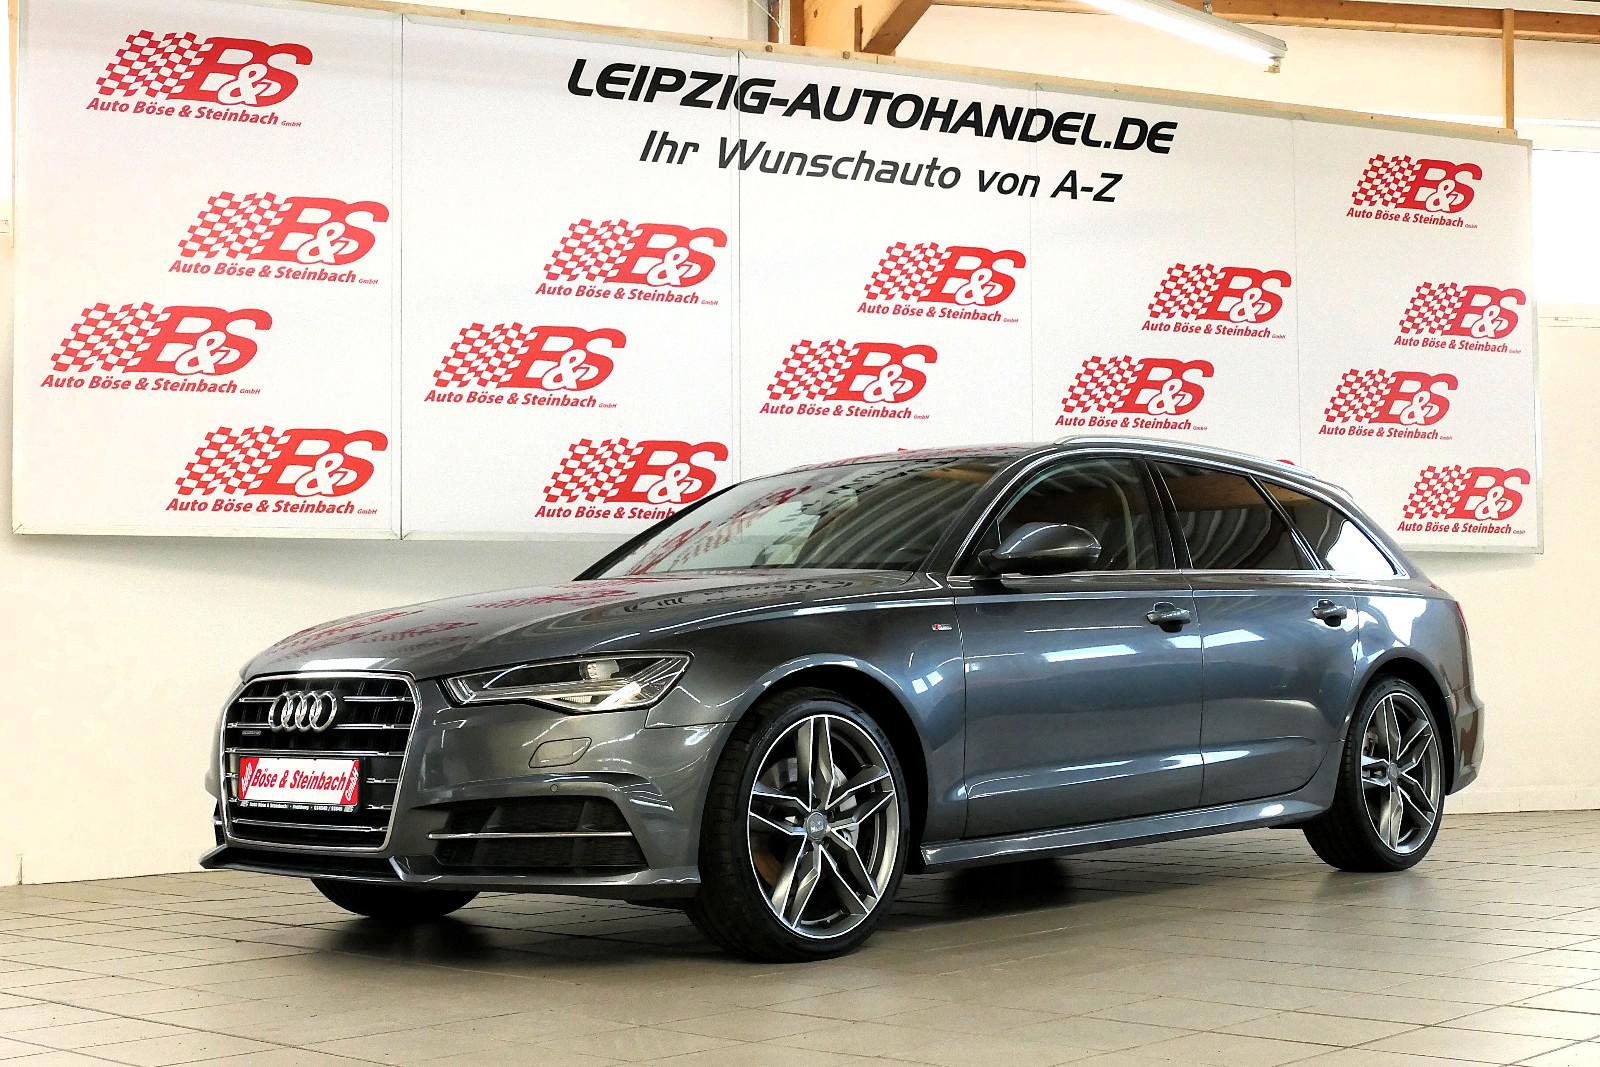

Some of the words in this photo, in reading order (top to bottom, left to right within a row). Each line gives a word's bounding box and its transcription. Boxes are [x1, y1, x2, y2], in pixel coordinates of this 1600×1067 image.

[86, 98, 129, 112] Auto
[132, 101, 175, 116] Böse
[178, 105, 192, 117] &
[194, 107, 278, 125] Steinbach
[567, 58, 1178, 155] LEIPZIG-AUTOHANDEL.DE
[639, 130, 700, 165] Ihr
[718, 136, 961, 189] Wunschauto
[978, 169, 1041, 198] von
[1050, 169, 1124, 203] A-Z
[1346, 207, 1373, 218] Auto
[1375, 209, 1400, 221] Böse
[1402, 212, 1411, 222] &
[1412, 213, 1463, 227] Steinbach
[168, 260, 211, 274] Auto
[214, 263, 255, 276] Böse
[258, 265, 272, 277] &
[274, 266, 356, 283] Steinbach
[536, 283, 572, 296] Auto
[575, 285, 611, 298] Böse
[614, 288, 625, 299] &
[629, 289, 699, 304] Steinbach
[858, 302, 889, 314] Auto
[892, 304, 923, 316] Böse
[926, 307, 936, 317] &
[940, 308, 1001, 321] Steinbach
[1141, 320, 1170, 331] Auto
[1173, 322, 1201, 333] Böse
[1204, 324, 1213, 334] &
[1215, 325, 1270, 338] Steinbach
[1394, 336, 1419, 346] Auto
[1422, 338, 1446, 348] Böse
[1448, 339, 1456, 349] &
[1458, 340, 1508, 352] Steinbach
[40, 375, 85, 388] Auto
[88, 376, 131, 389] Böse
[135, 378, 149, 390] &
[151, 378, 237, 393] Steinbach
[425, 390, 463, 403] Auto
[466, 391, 504, 404] Böse
[507, 393, 519, 404] &
[521, 393, 596, 407] Steinbach
[760, 403, 794, 414] Auto
[797, 404, 830, 415] Böse
[833, 405, 843, 416] &
[846, 405, 911, 418] Steinbach
[1056, 415, 1085, 426] Auto
[1088, 416, 1118, 427] Böse
[1120, 417, 1130, 428] &
[1133, 418, 1191, 430] Steinbach
[1318, 425, 1346, 435] Auto
[1348, 426, 1374, 436] Böse
[1376, 427, 1385, 437] &
[1386, 428, 1438, 439] Steinbach
[165, 498, 208, 511] Auto
[212, 499, 253, 512] Böse
[256, 500, 269, 512] &
[272, 500, 354, 514] Steinbach
[535, 506, 572, 518] Auto
[575, 506, 611, 518] Böse
[613, 507, 625, 519] &
[628, 507, 676, 519] Steinb
[1397, 521, 1423, 531] Auto
[1425, 522, 1450, 532] Böse
[1452, 523, 1460, 532] &
[1461, 523, 1512, 534] Steinbach
[251, 768, 278, 788] Böse
[279, 769, 290, 789] &
[290, 769, 347, 791] Steinbach
